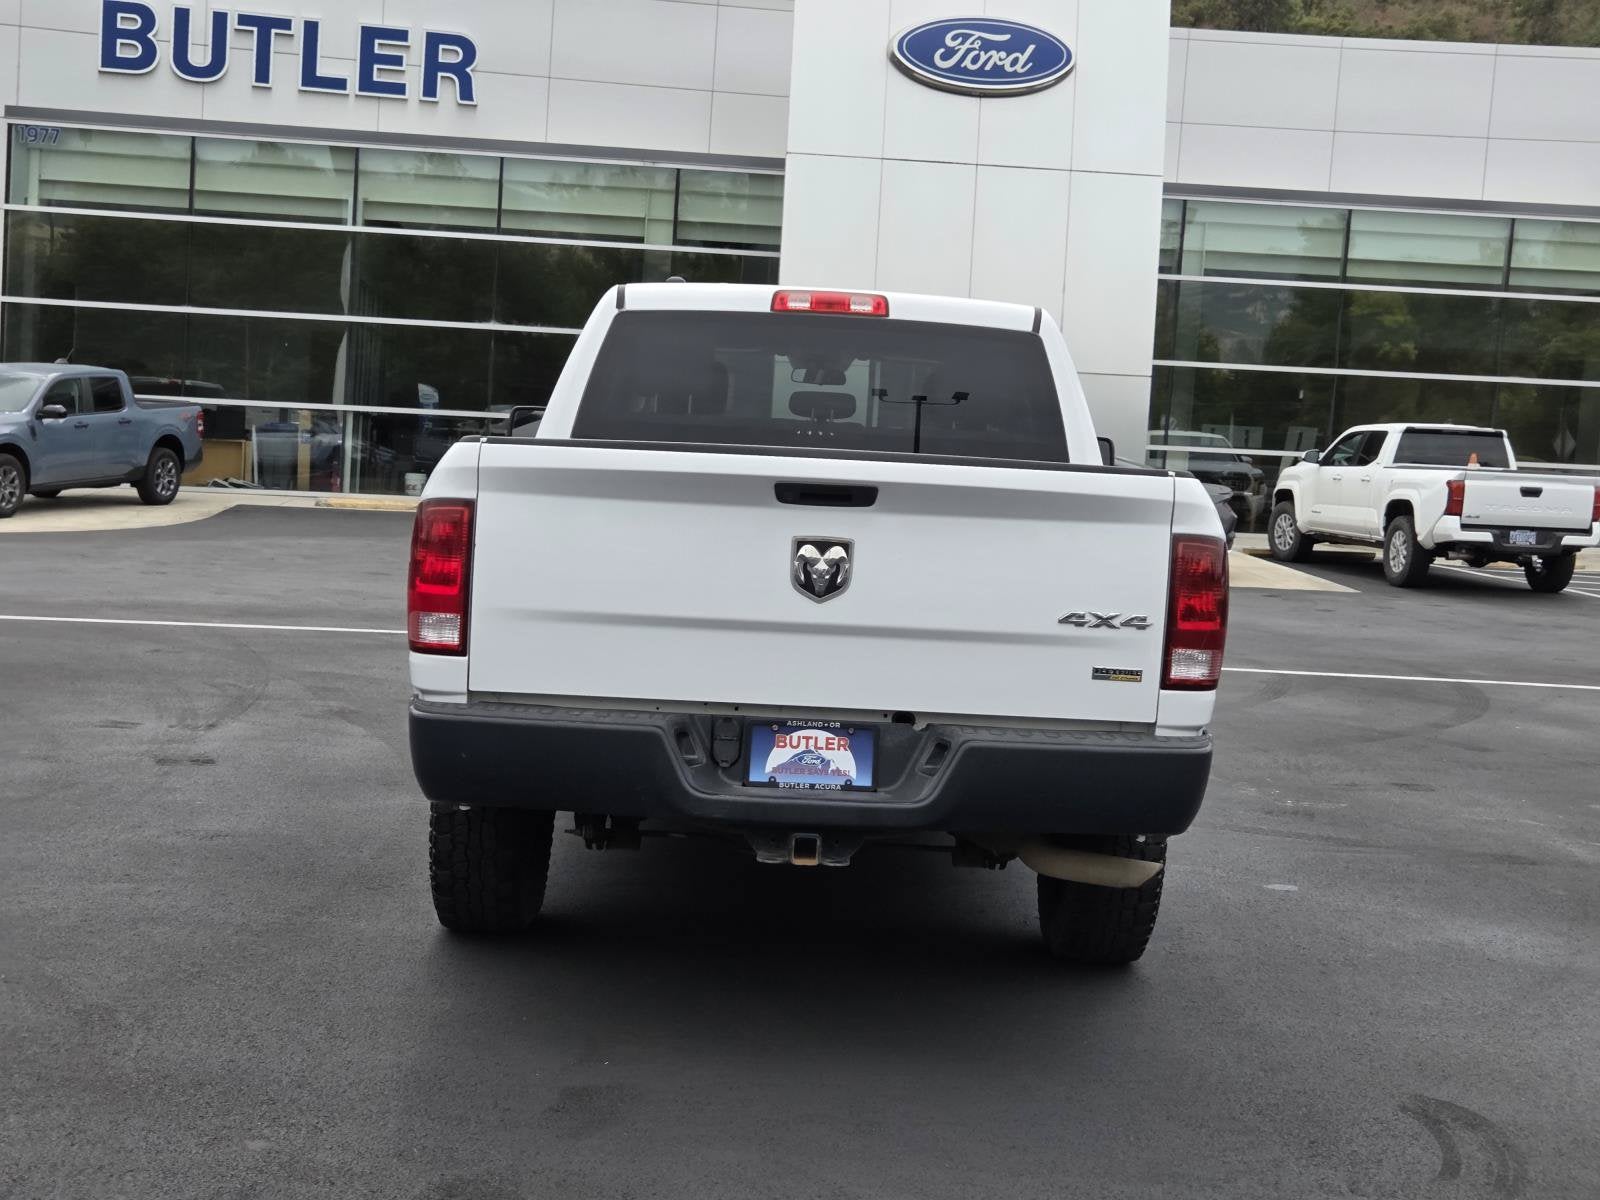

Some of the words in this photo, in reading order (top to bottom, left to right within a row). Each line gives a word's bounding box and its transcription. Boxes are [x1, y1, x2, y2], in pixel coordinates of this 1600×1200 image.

[99, 0, 478, 106] BUTLER
[933, 29, 1036, 74] Ford
[16, 125, 60, 144] 1977
[775, 733, 850, 752] BUTLER
[801, 755, 822, 765] Ford
[778, 782, 810, 790] BUTLER
[814, 783, 842, 791] ACURA
